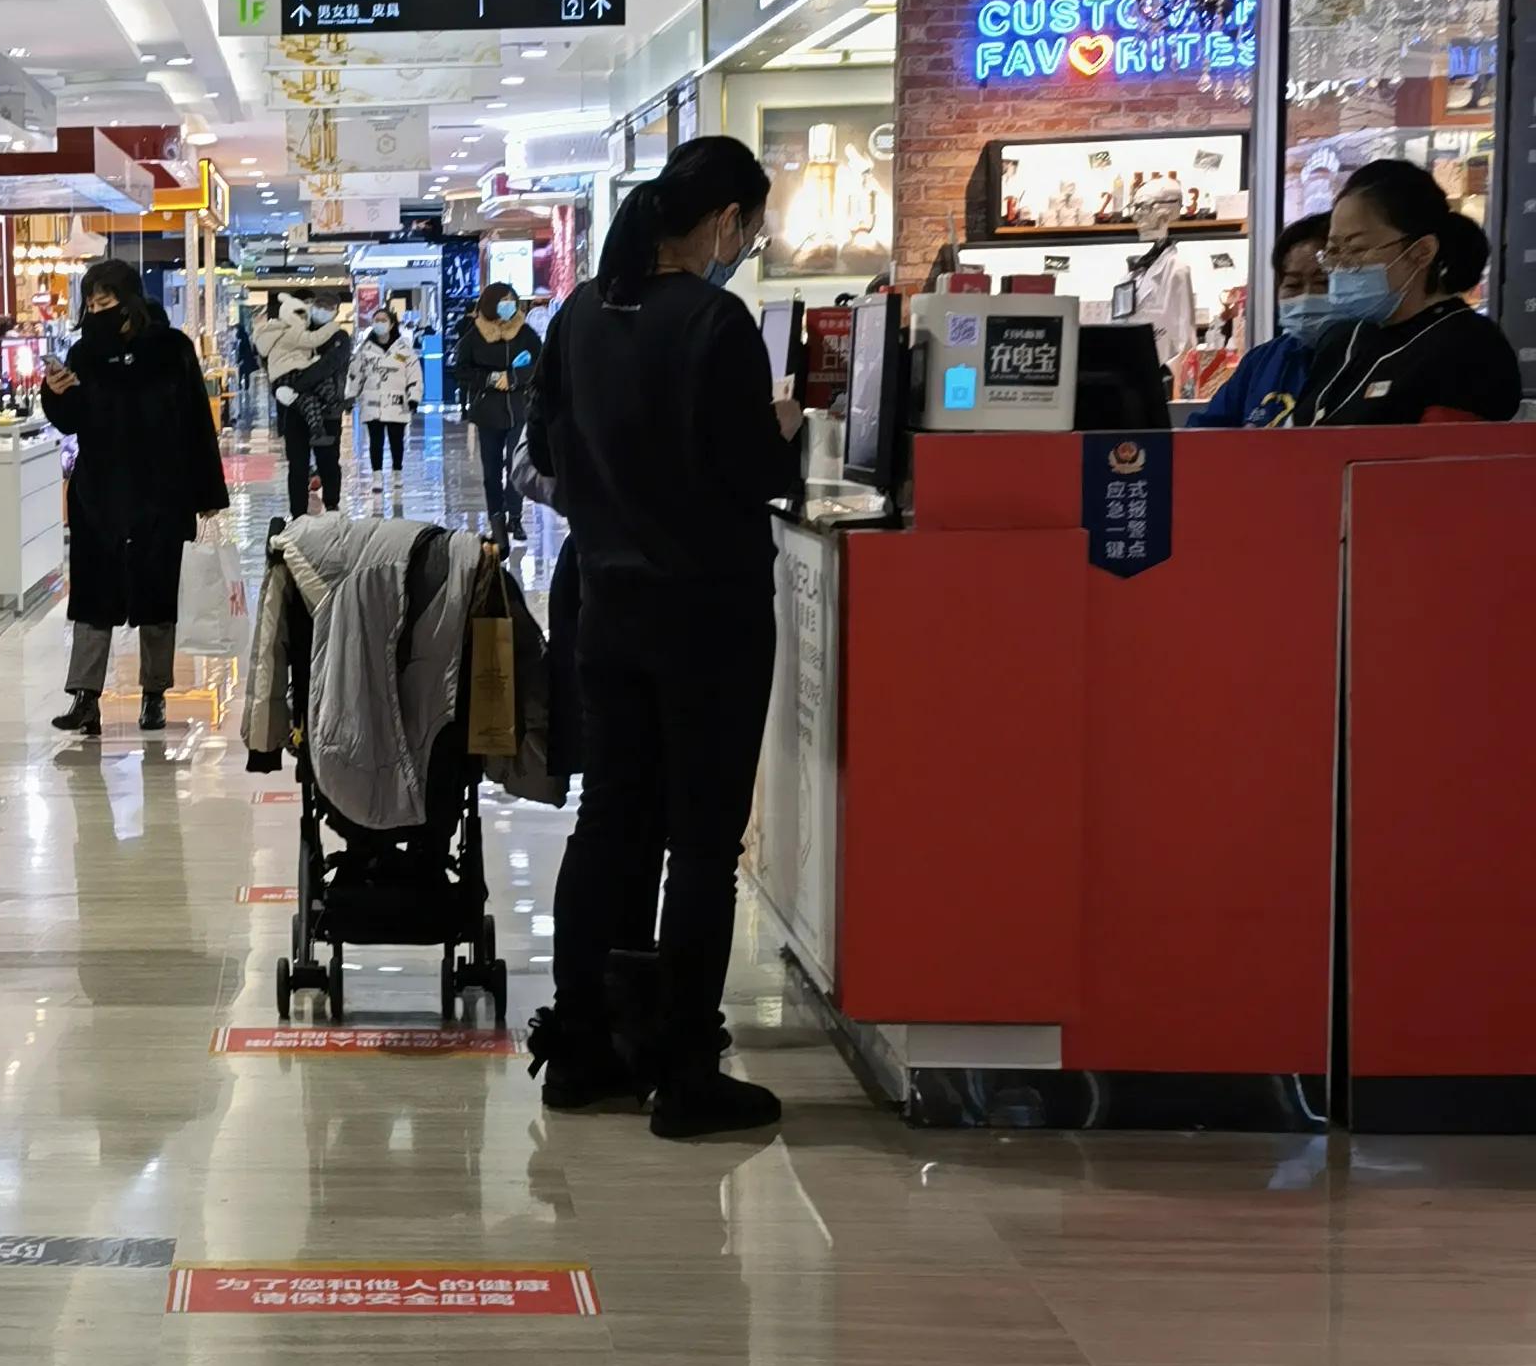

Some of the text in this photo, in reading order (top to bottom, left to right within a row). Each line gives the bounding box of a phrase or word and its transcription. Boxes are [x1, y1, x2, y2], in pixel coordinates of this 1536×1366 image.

[990, 342, 1057, 373] 充电宝
[216, 1278, 551, 1292] 为了您和他人的健康
[252, 1292, 516, 1306] 请保持安全距离
